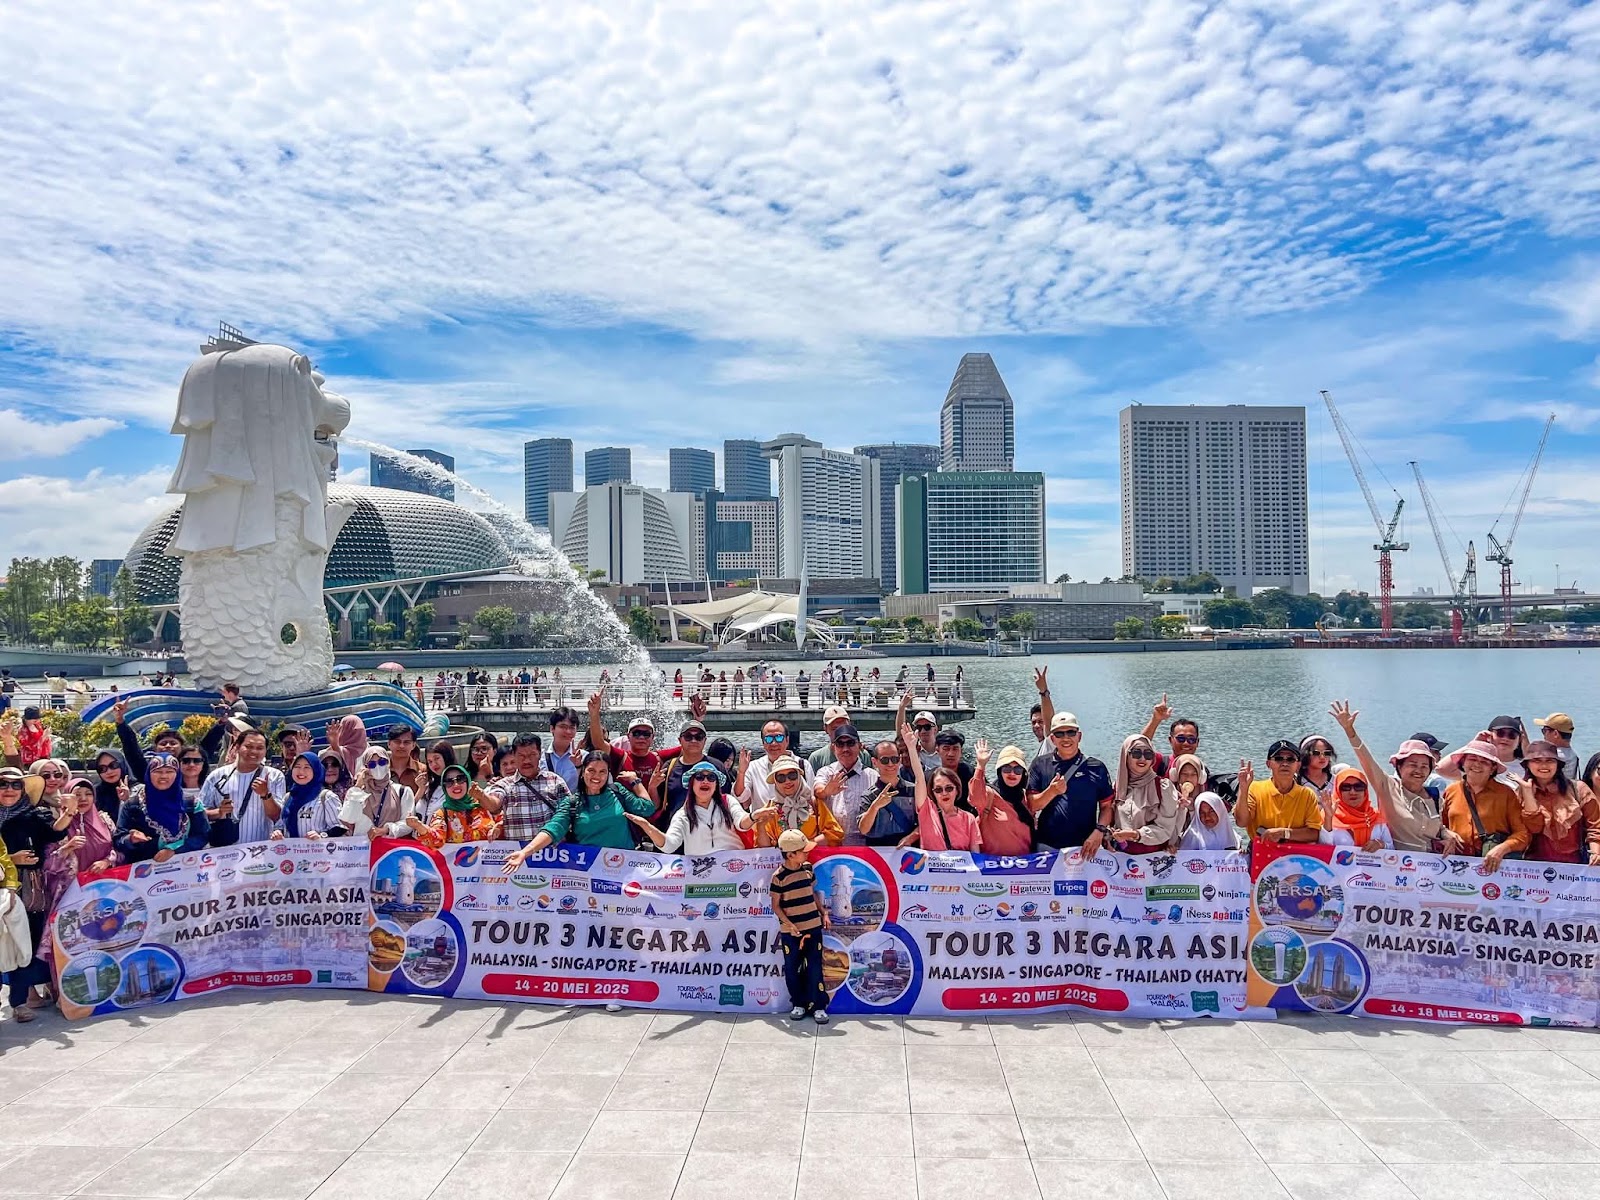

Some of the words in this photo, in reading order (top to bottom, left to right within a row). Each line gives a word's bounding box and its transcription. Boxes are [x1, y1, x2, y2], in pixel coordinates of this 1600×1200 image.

[839, 454, 856, 462] PACIFIC
[532, 848, 570, 863] BUS
[576, 851, 586, 865] 1
[985, 857, 1028, 869] BUS
[1036, 856, 1047, 868] 2
[1500, 871, 1521, 879] Trivat
[1523, 872, 1540, 880] Tour
[1559, 874, 1600, 882] NinjaTrave
[562, 880, 588, 890] gateway
[593, 882, 618, 891] Tripee
[902, 884, 929, 892] SUCI
[1021, 885, 1052, 894] gateway
[1057, 883, 1084, 892] Tripee
[1355, 880, 1386, 888] travelkita
[1218, 890, 1250, 900] NinjaTra
[158, 899, 220, 925] TOUR
[226, 896, 240, 910] 2
[244, 888, 322, 908] NEGARA
[326, 887, 366, 904] ASIA
[723, 906, 747, 914] iNess
[1186, 910, 1211, 918] iNess
[1213, 912, 1243, 920] Agatha
[175, 918, 259, 943] MALAYSIA
[276, 912, 362, 926] SINGAPORE
[1353, 905, 1414, 928] TOUR
[1420, 910, 1432, 928] 2
[1438, 913, 1537, 938] NEGARA
[1543, 922, 1598, 944] ASIA
[471, 920, 550, 946] TOUR
[560, 924, 575, 947] 3
[587, 926, 711, 953] NEGARA
[722, 929, 784, 954] ASIA
[926, 931, 1015, 956] TOUR
[1026, 930, 1041, 955] 3
[1053, 930, 1176, 959] NEGARA
[1366, 934, 1457, 956] MALAYSIA
[1476, 945, 1594, 969] SINGAPORE
[471, 953, 538, 967] MALAYSIA
[551, 956, 637, 972] SINGAPORE
[651, 961, 723, 976] THAILAND
[928, 965, 1004, 980] MALAYSIA
[1019, 964, 1101, 980] SINGAPORE
[1116, 969, 1191, 983] THAILAND
[207, 977, 221, 988] 14
[232, 975, 243, 984] 17
[246, 974, 263, 983] MEI
[266, 973, 294, 982] 2025
[515, 980, 530, 991] 14
[543, 981, 559, 992] 20
[563, 982, 589, 993] MEI
[594, 983, 629, 995] 2025
[980, 993, 997, 1004] 14
[1012, 992, 1030, 1003] 20
[1035, 990, 1060, 1002] MEI
[1065, 988, 1097, 1003] 2025
[1391, 1004, 1405, 1014] 14
[1418, 1007, 1433, 1016] 18
[1438, 1009, 1462, 1019] MEI
[1466, 1012, 1499, 1022] 2025
